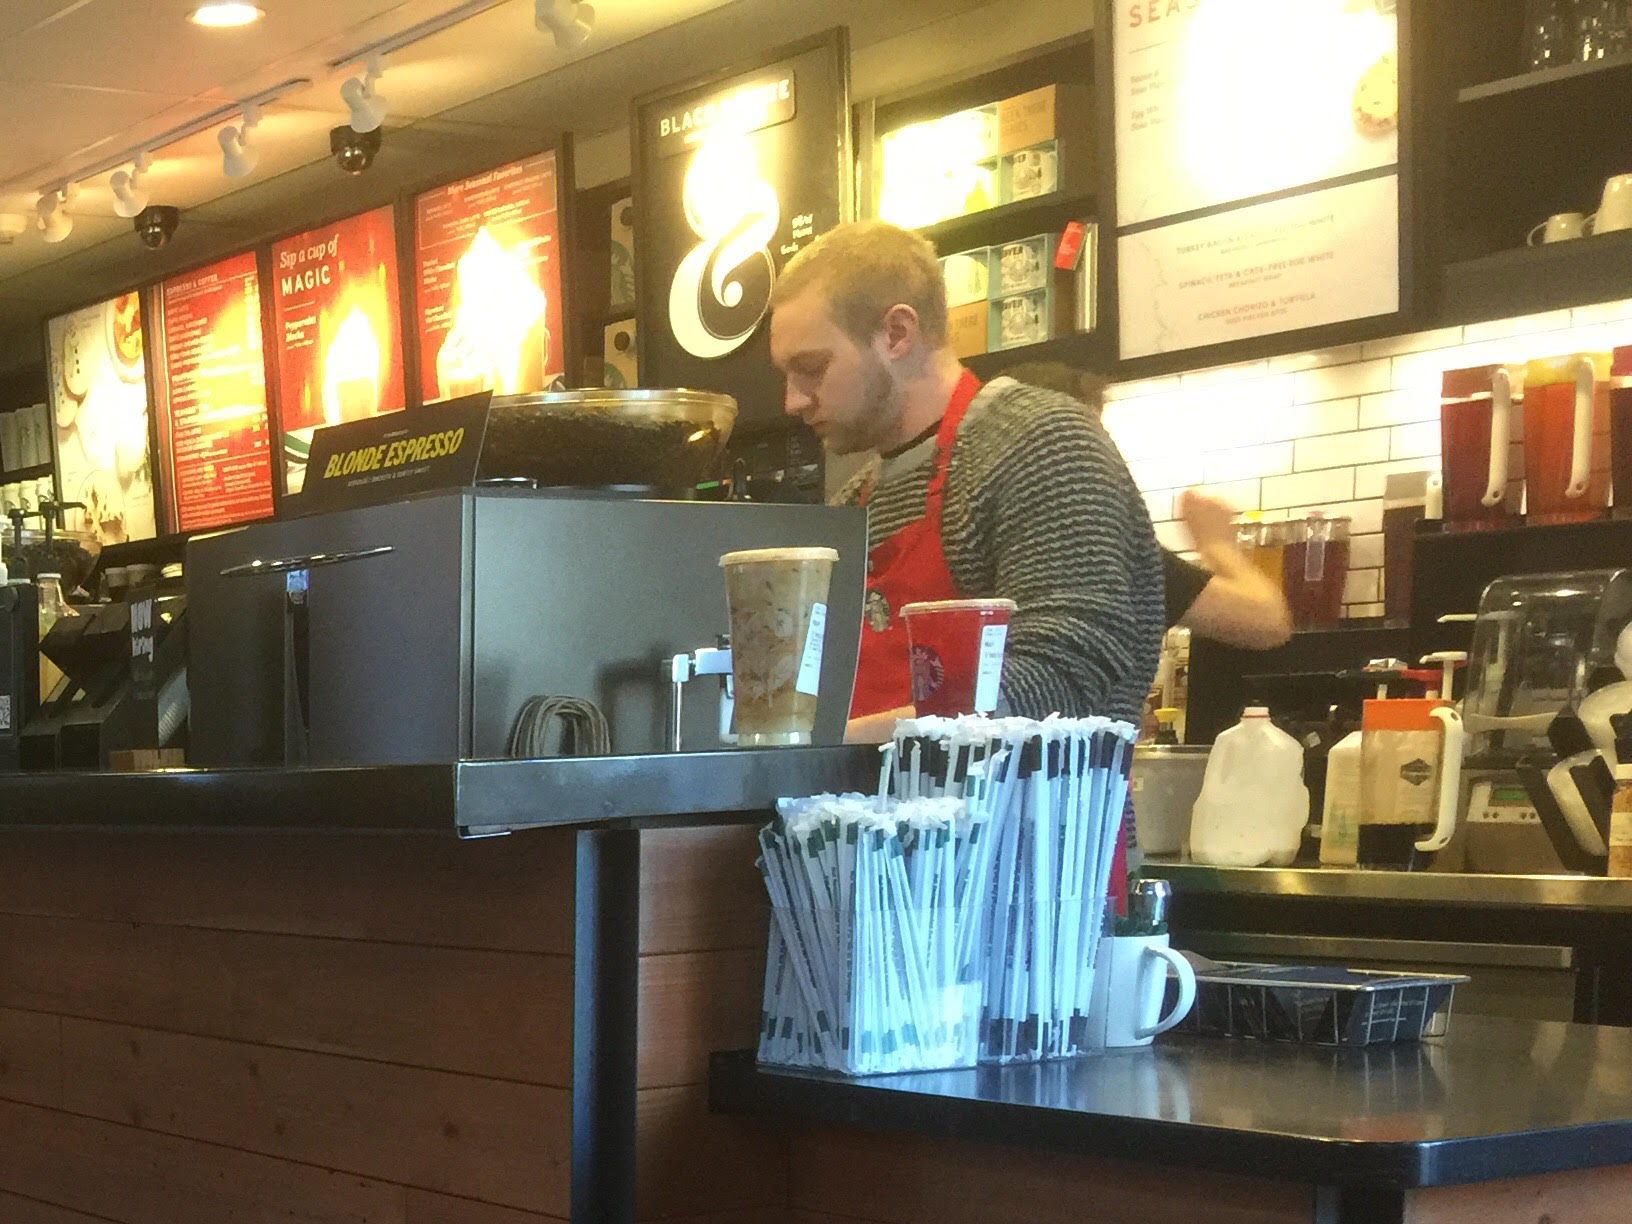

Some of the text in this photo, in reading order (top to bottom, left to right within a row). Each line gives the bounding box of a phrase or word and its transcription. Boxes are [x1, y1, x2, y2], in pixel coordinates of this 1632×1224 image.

[279, 233, 340, 270] Sip a cup of
[281, 264, 331, 297] MAGIC
[323, 427, 465, 479] BLONDE ESPRESSO
